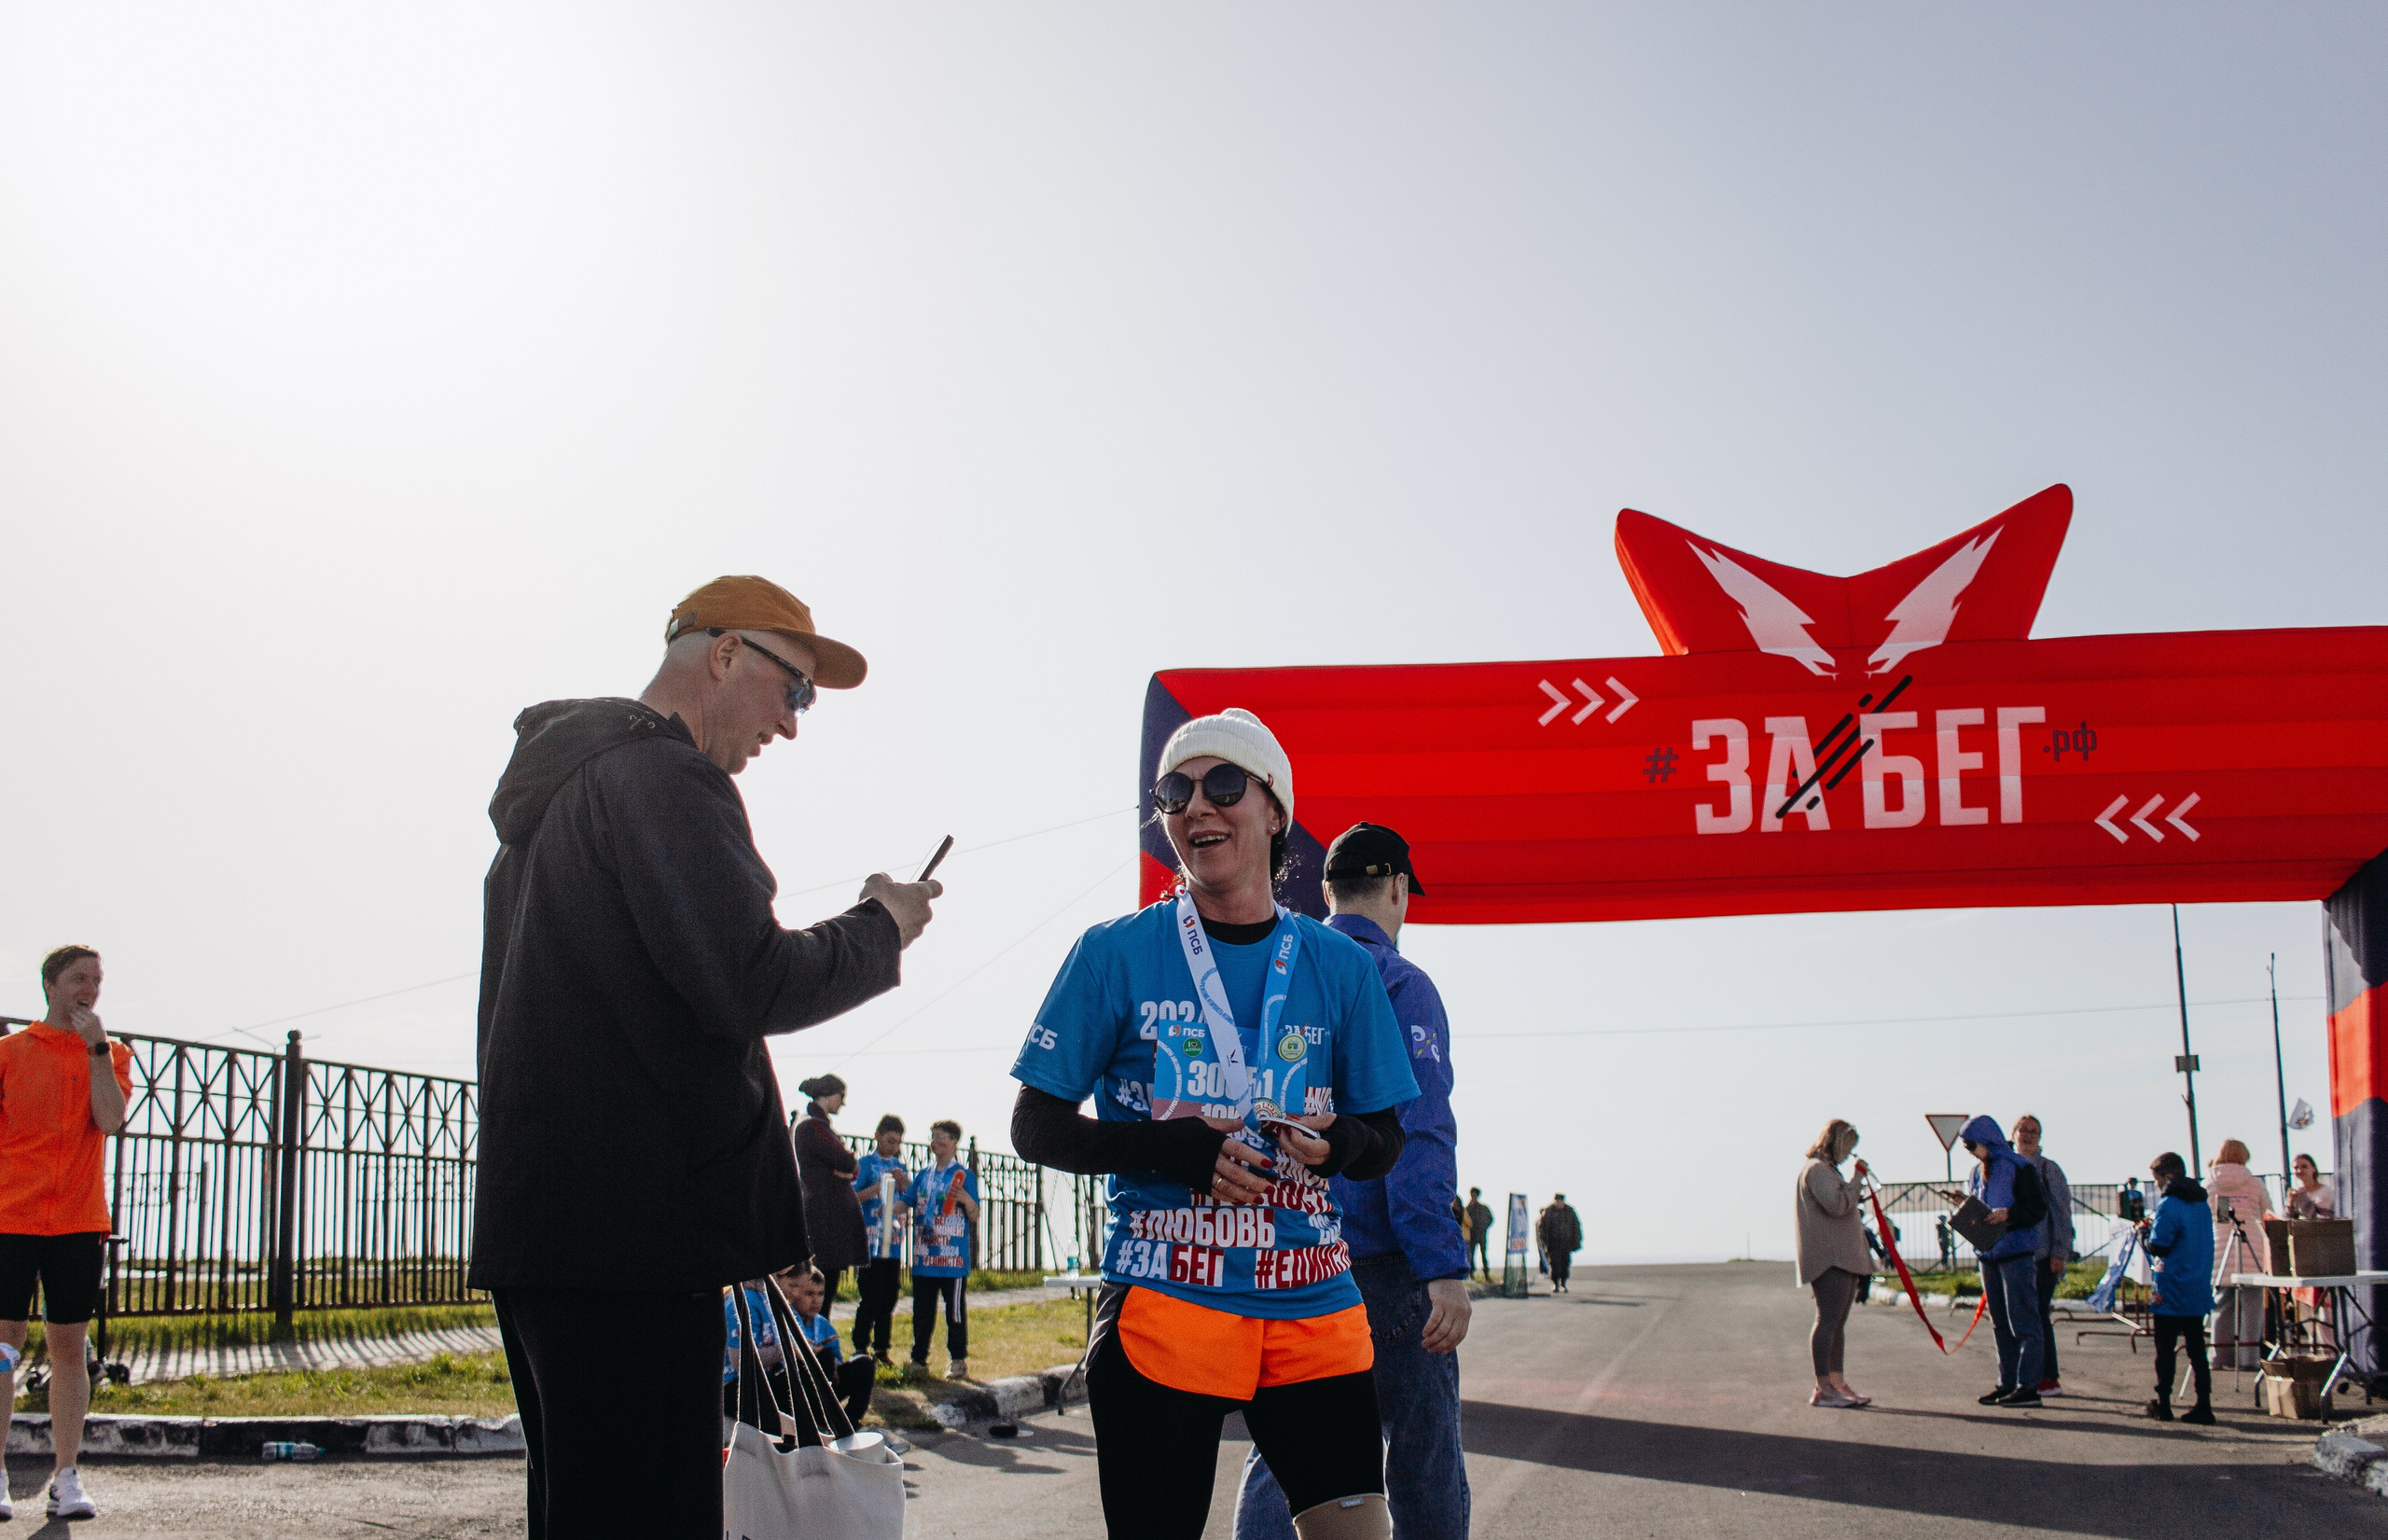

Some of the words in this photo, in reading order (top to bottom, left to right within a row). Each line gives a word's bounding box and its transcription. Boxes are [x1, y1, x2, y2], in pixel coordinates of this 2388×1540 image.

[1187, 929, 1203, 955] ПСБ
[1279, 934, 1294, 959] ПСБ
[1029, 1022, 1058, 1050] СБ
[1183, 1028, 1205, 1038] ПСБ
[1187, 1060, 1273, 1103] 3051
[1129, 1207, 1275, 1248] #ЛЮБОВЬ
[1116, 1239, 1225, 1287] #ЗАБЕГ
